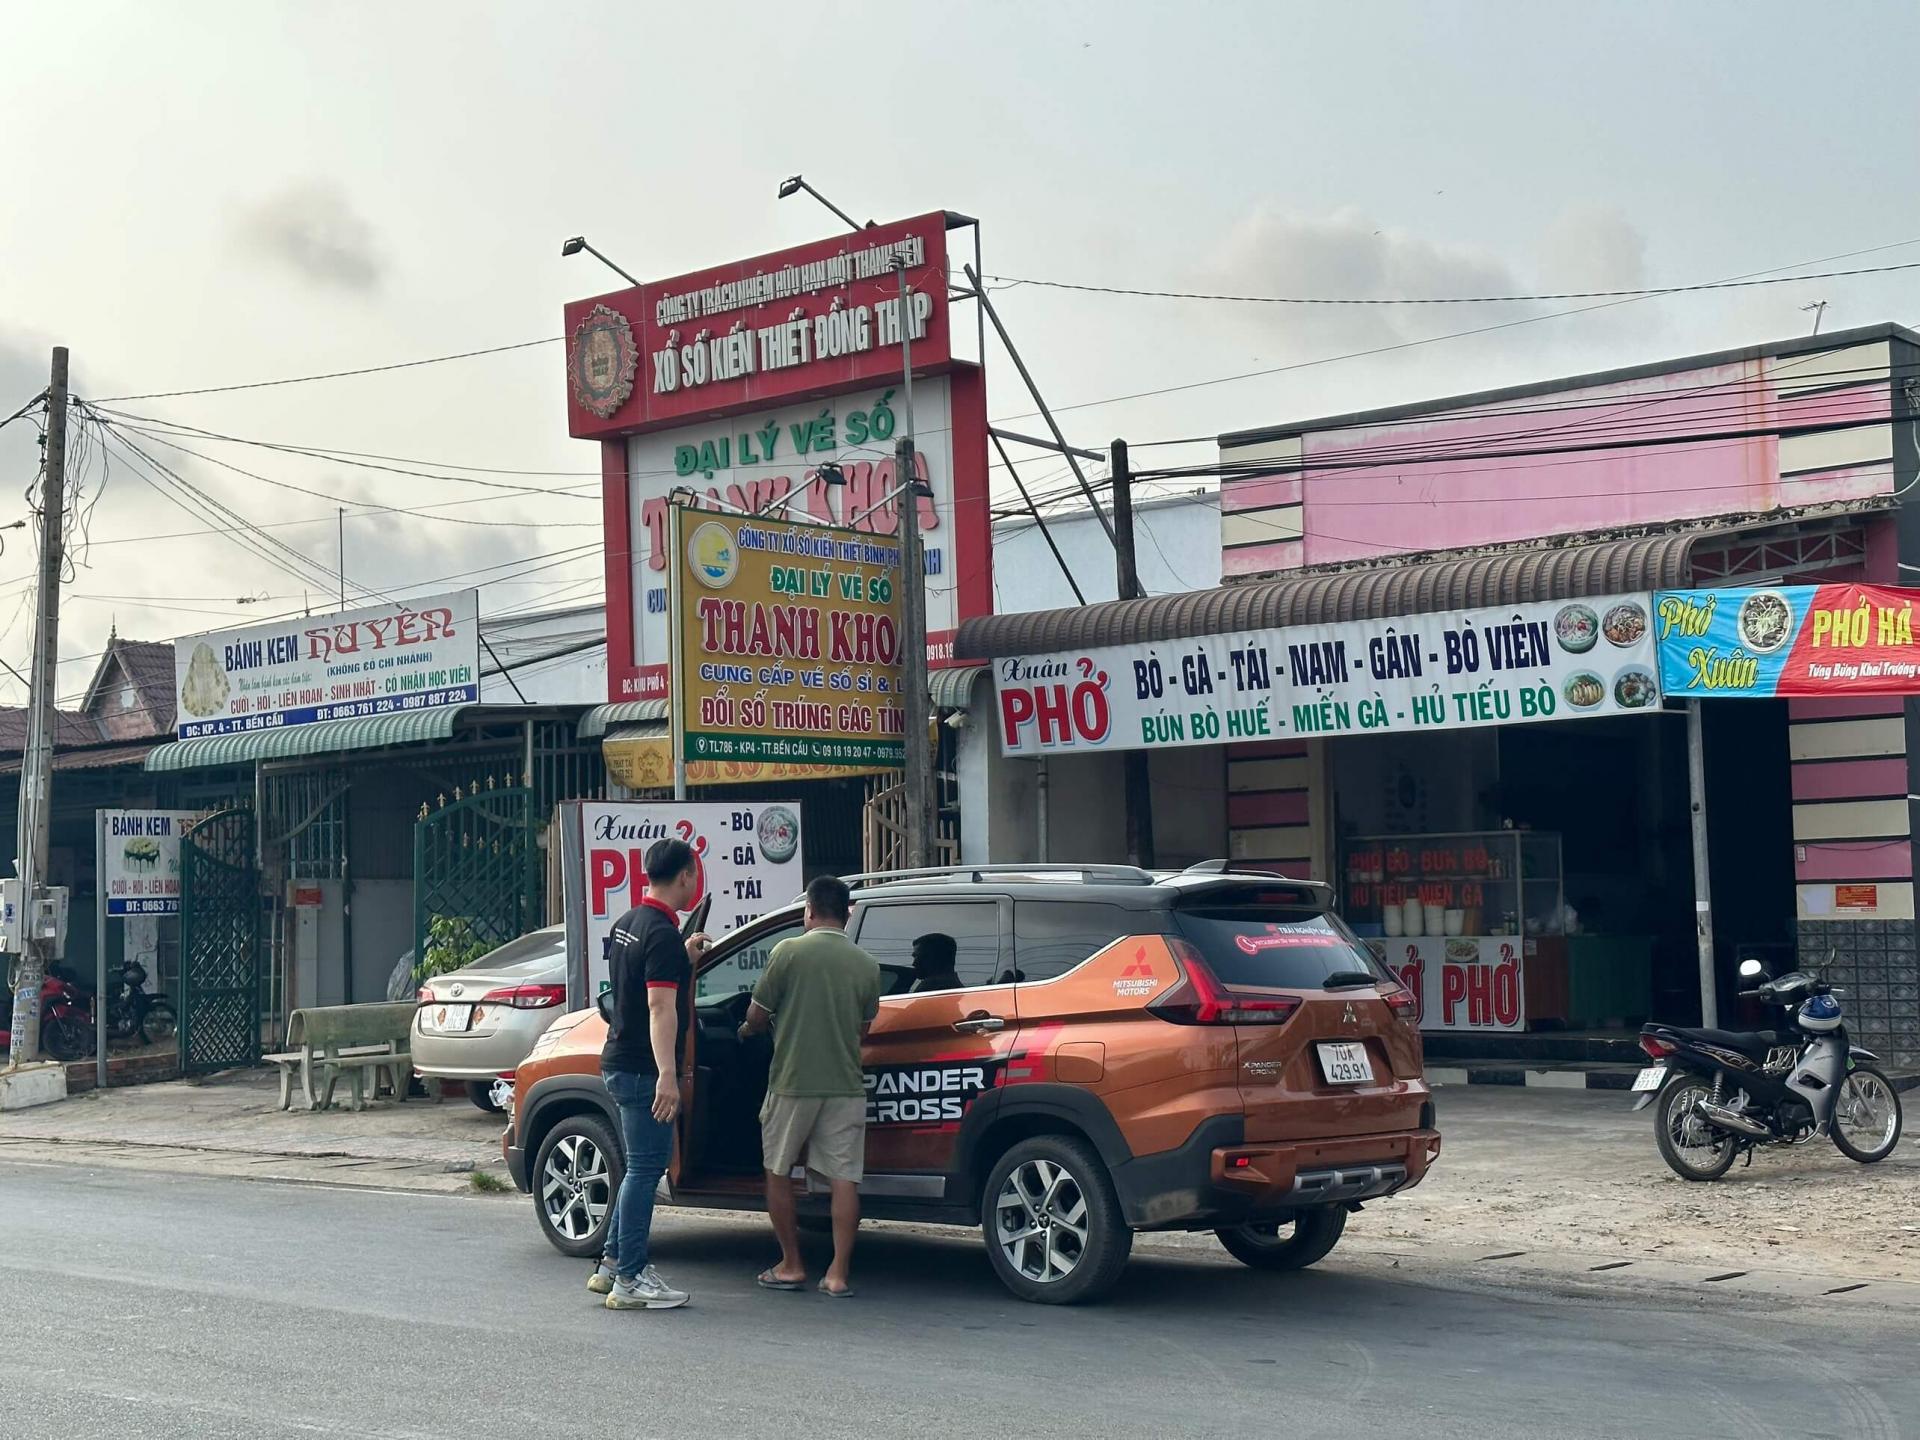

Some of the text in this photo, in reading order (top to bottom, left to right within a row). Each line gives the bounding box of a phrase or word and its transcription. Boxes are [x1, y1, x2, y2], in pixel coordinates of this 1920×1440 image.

[656, 292, 685, 327] CÔNG
[685, 293, 700, 320] TY
[701, 280, 737, 315] TRÁCH
[737, 270, 775, 309] NHIỆM
[776, 264, 801, 298] HỮU
[802, 262, 827, 296] HẠN
[827, 249, 854, 289] MỘT
[653, 285, 933, 393] XỔ SỐ KIẾN THIẾT ĐỒNG THÁP
[674, 390, 896, 480] ĐẠI LÝ VÉ SỐ
[738, 522, 901, 567] CÔNG TY XỔ SỐ KIẾN THIẾT BÌNH PH
[771, 563, 893, 604] ĐẠI LÝ VÉ SỐ
[699, 597, 820, 659] THANH
[1659, 594, 1717, 640] Phở
[1812, 595, 1912, 648] PHỞ HÀ
[225, 607, 456, 672] BÁNH KEM HUYÊN
[926, 641, 954, 661] 0918.19
[379, 656, 394, 669] CHI
[1133, 614, 1551, 699] BÒ GÀ TÁI NẠM GÂN BÒ VIÊN
[1688, 647, 1759, 690] Xuân
[1859, 661, 1881, 677] Khai
[634, 675, 646, 692] KHU
[647, 671, 659, 691] PHỐ
[660, 676, 665, 689] 4
[700, 660, 904, 694] CUNG CẤP VÉ SỐ SỈ & L
[1002, 658, 1070, 682] Xuân
[278, 688, 298, 708] LIÊN
[299, 687, 323, 706] HOAN
[330, 682, 351, 702] SINH
[353, 679, 376, 699] NHẬT
[385, 674, 398, 693] CÓ
[400, 670, 426, 692] NHẬN
[428, 668, 447, 688] HỌC
[449, 664, 471, 685] VIÊN
[186, 725, 202, 737] ĐC:
[202, 723, 217, 736] KP.
[218, 722, 225, 733] 4
[231, 719, 244, 732] TT.
[245, 715, 265, 730] BẾN
[317, 707, 331, 721] ĐT:
[333, 704, 355, 719] 0663
[356, 702, 374, 717] 761
[376, 699, 395, 714] 224
[402, 696, 426, 711] 0987
[428, 693, 447, 707] 887
[448, 690, 468, 704] 224
[701, 685, 904, 735] ĐỔI SỐ TRÚNG CÁC TỈN
[1001, 658, 1110, 746] PHỞ
[1141, 678, 1556, 743] BÚN BÒ HUẾ MIẾN GÀ HỦ TIẾU BÒ
[709, 740, 732, 754] TL786
[740, 741, 755, 755] KP4
[762, 738, 791, 756] TT.BẾN
[822, 747, 831, 757] 09
[833, 747, 842, 757] 18
[843, 748, 852, 757] 19
[852, 748, 862, 758] 20
[863, 748, 871, 758] 47
[112, 813, 143, 836] BÁNH
[146, 817, 171, 836] KEM
[594, 815, 669, 840] Xuân
[731, 808, 753, 831] BÒ
[733, 843, 755, 865] GÀ
[149, 876, 163, 894] LIÊN
[165, 879, 180, 894] HOA
[734, 876, 762, 899] TÁI
[126, 900, 140, 911] ĐT:
[167, 900, 180, 911] 76
[1113, 979, 1158, 988] MITSUBISHI
[1117, 987, 1150, 997] MOTORS
[1443, 943, 1520, 1027] PHỞ
[1331, 1045, 1354, 1061] 70A
[863, 1067, 985, 1094] PANDER
[1331, 1063, 1368, 1081] 429.91
[866, 1097, 962, 1122] CROSS
